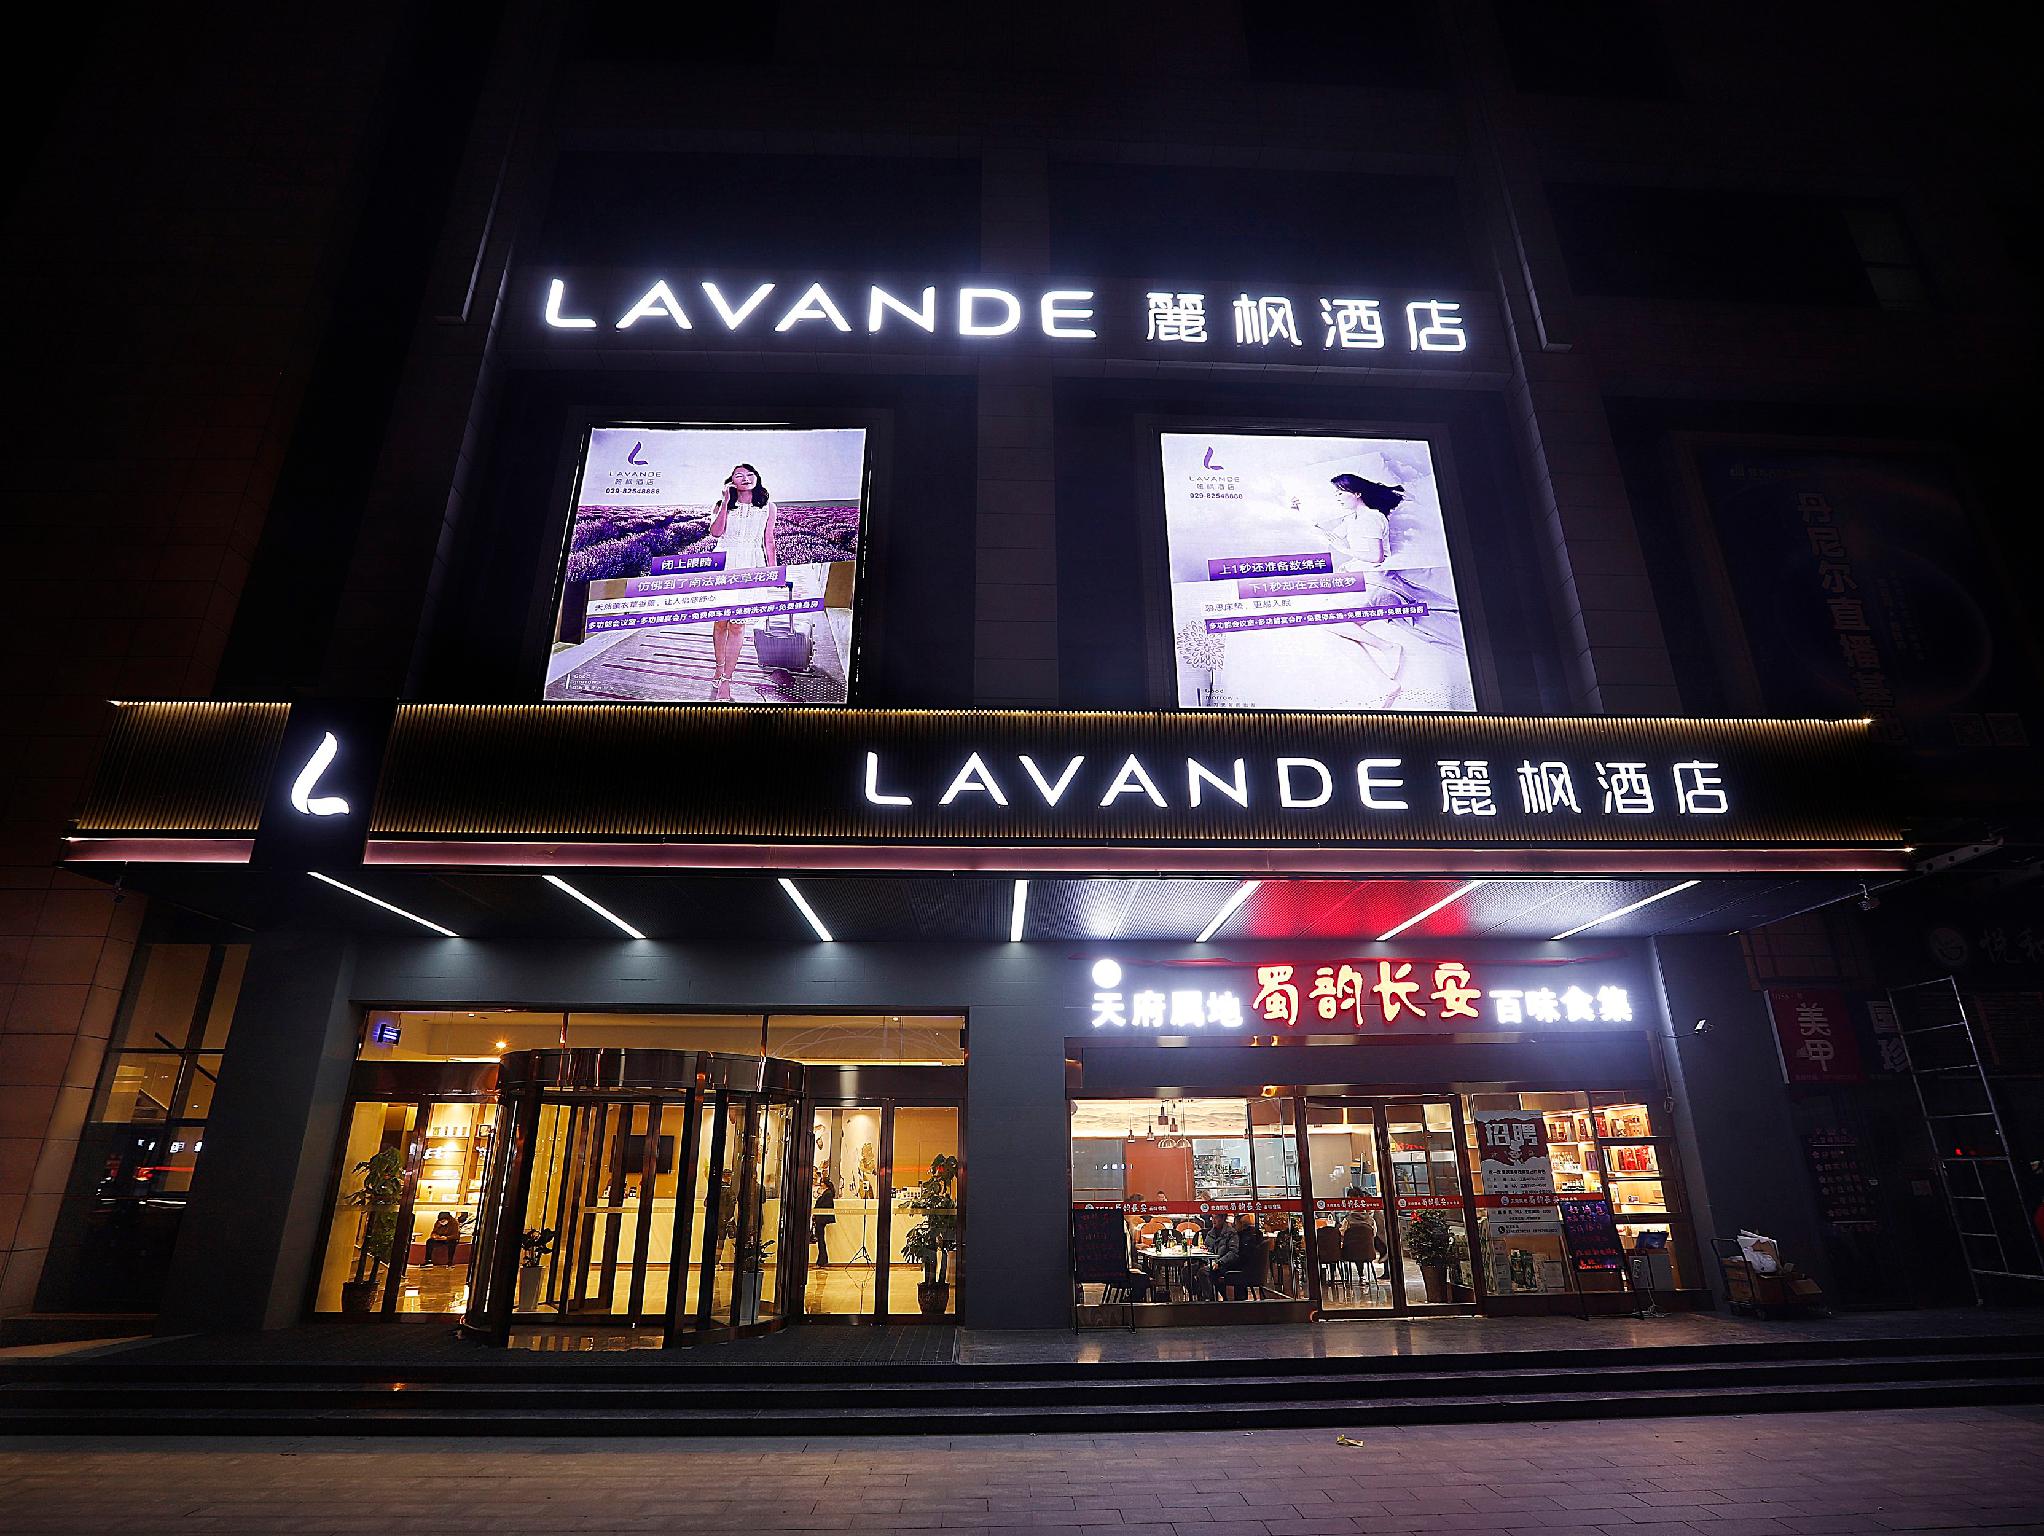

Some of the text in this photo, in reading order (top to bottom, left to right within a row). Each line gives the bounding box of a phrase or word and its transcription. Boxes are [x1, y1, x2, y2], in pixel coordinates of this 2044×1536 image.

[544, 277, 1468, 354] LAVANDE 麗枫酒店
[1218, 559, 1327, 575] 上1秒还准备数绵羊
[1248, 577, 1357, 593] 下1秒却在云端做梦
[864, 750, 1729, 817] LAVANDE 麗枫酒店
[1252, 962, 1482, 1026] 蜀韵长安
[1795, 1002, 1836, 1072] 美甲
[1484, 1123, 1539, 1146] 招聘
